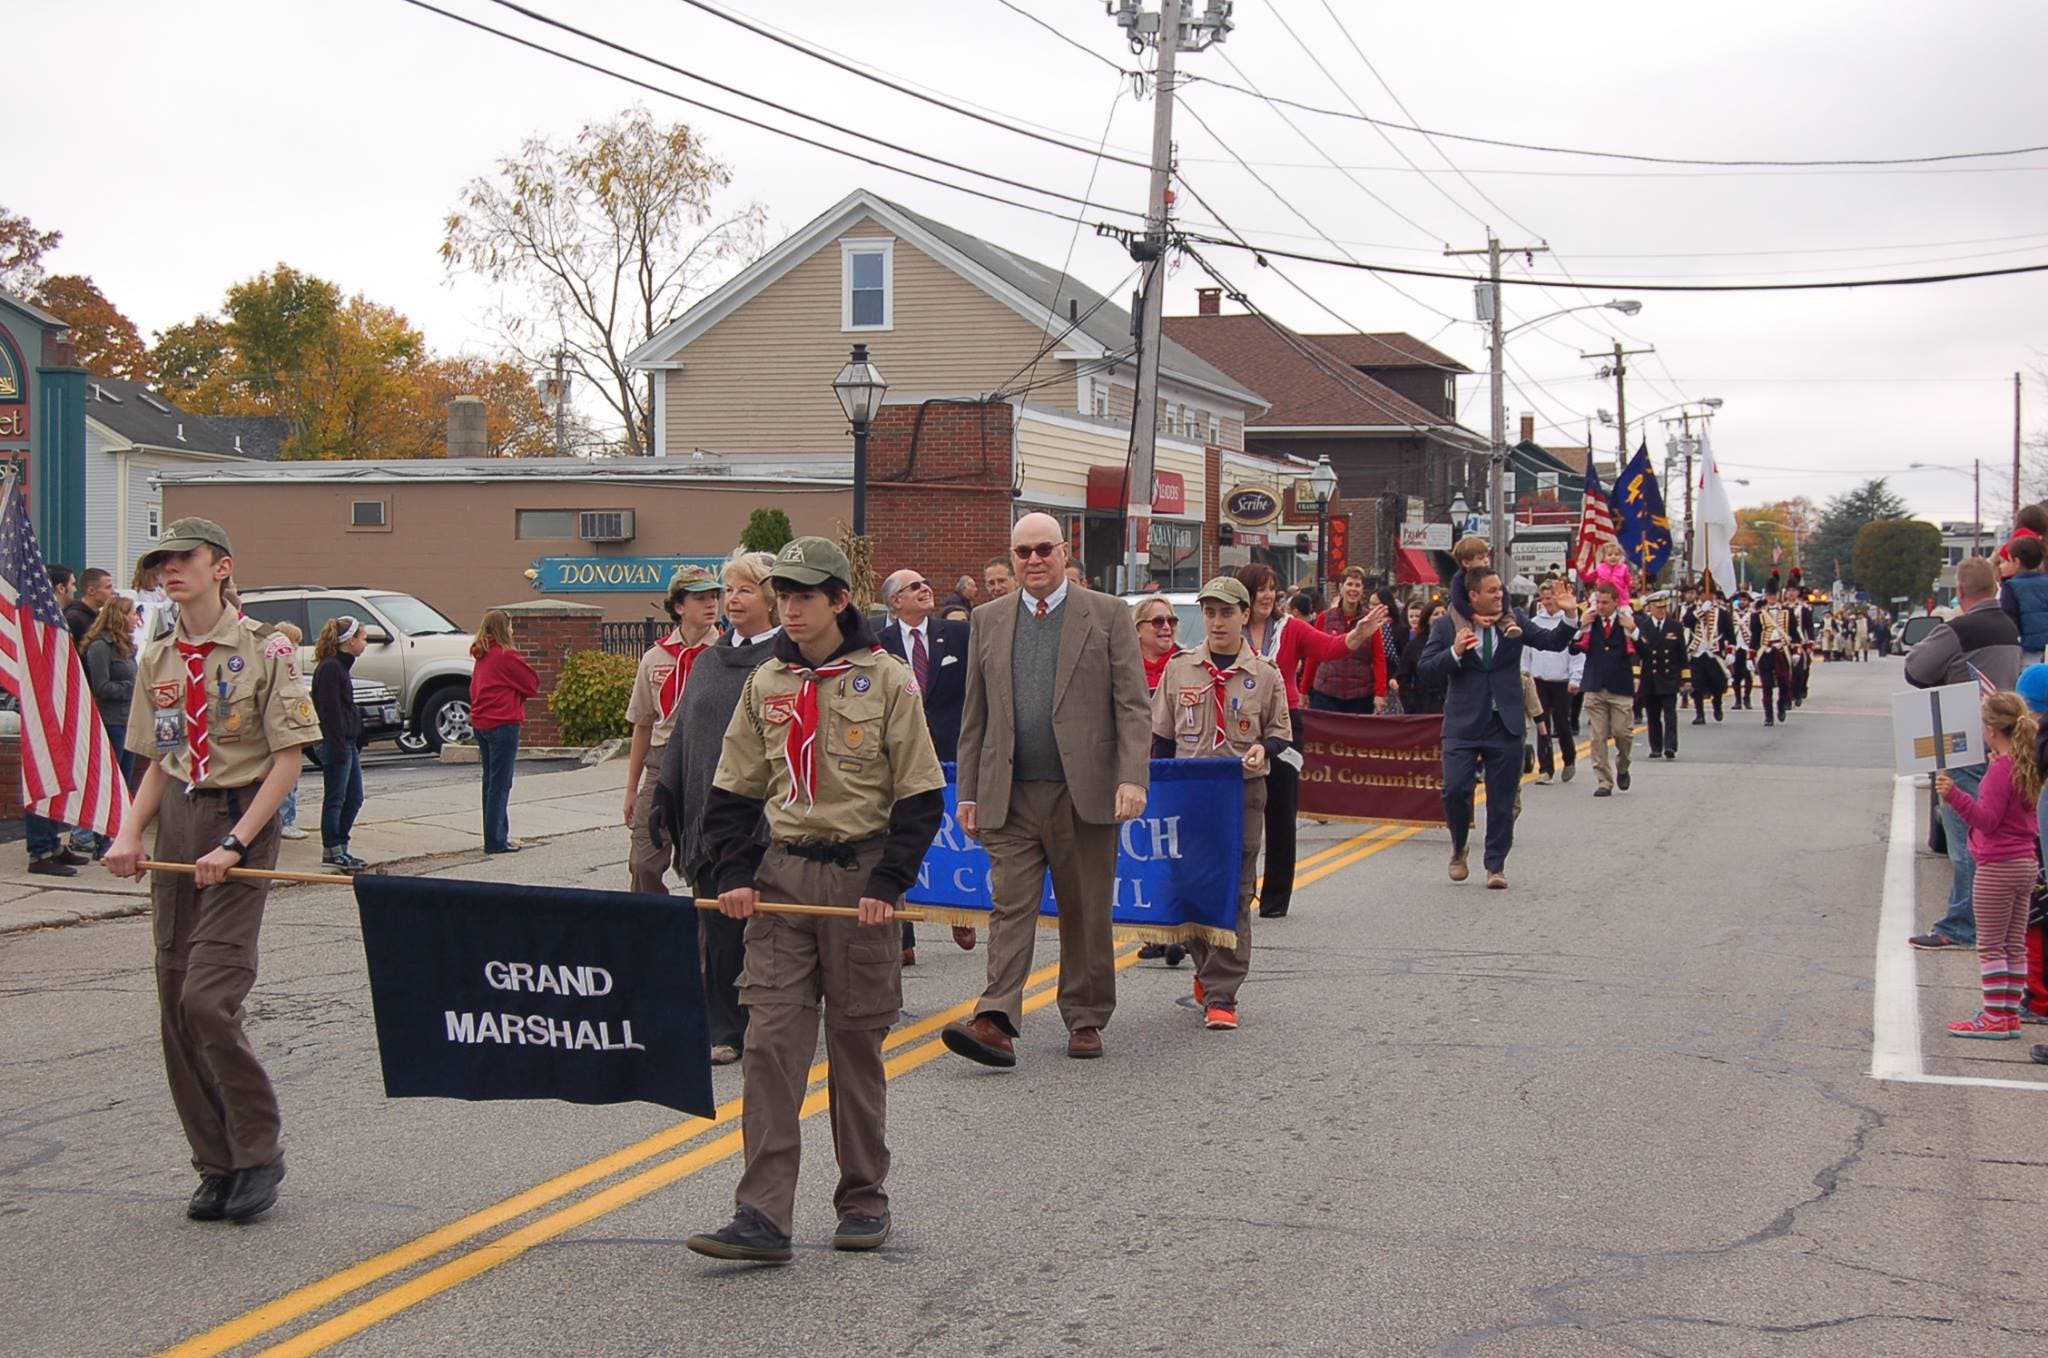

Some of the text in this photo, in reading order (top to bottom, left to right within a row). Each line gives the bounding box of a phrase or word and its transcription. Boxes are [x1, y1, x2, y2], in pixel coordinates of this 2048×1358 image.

[558, 563, 663, 585] DONOVAN
[1303, 741, 1442, 762] st Greenwich
[1299, 766, 1446, 790] ool Committe
[484, 961, 613, 997] GRAND
[445, 1011, 645, 1051] MARSHALL
